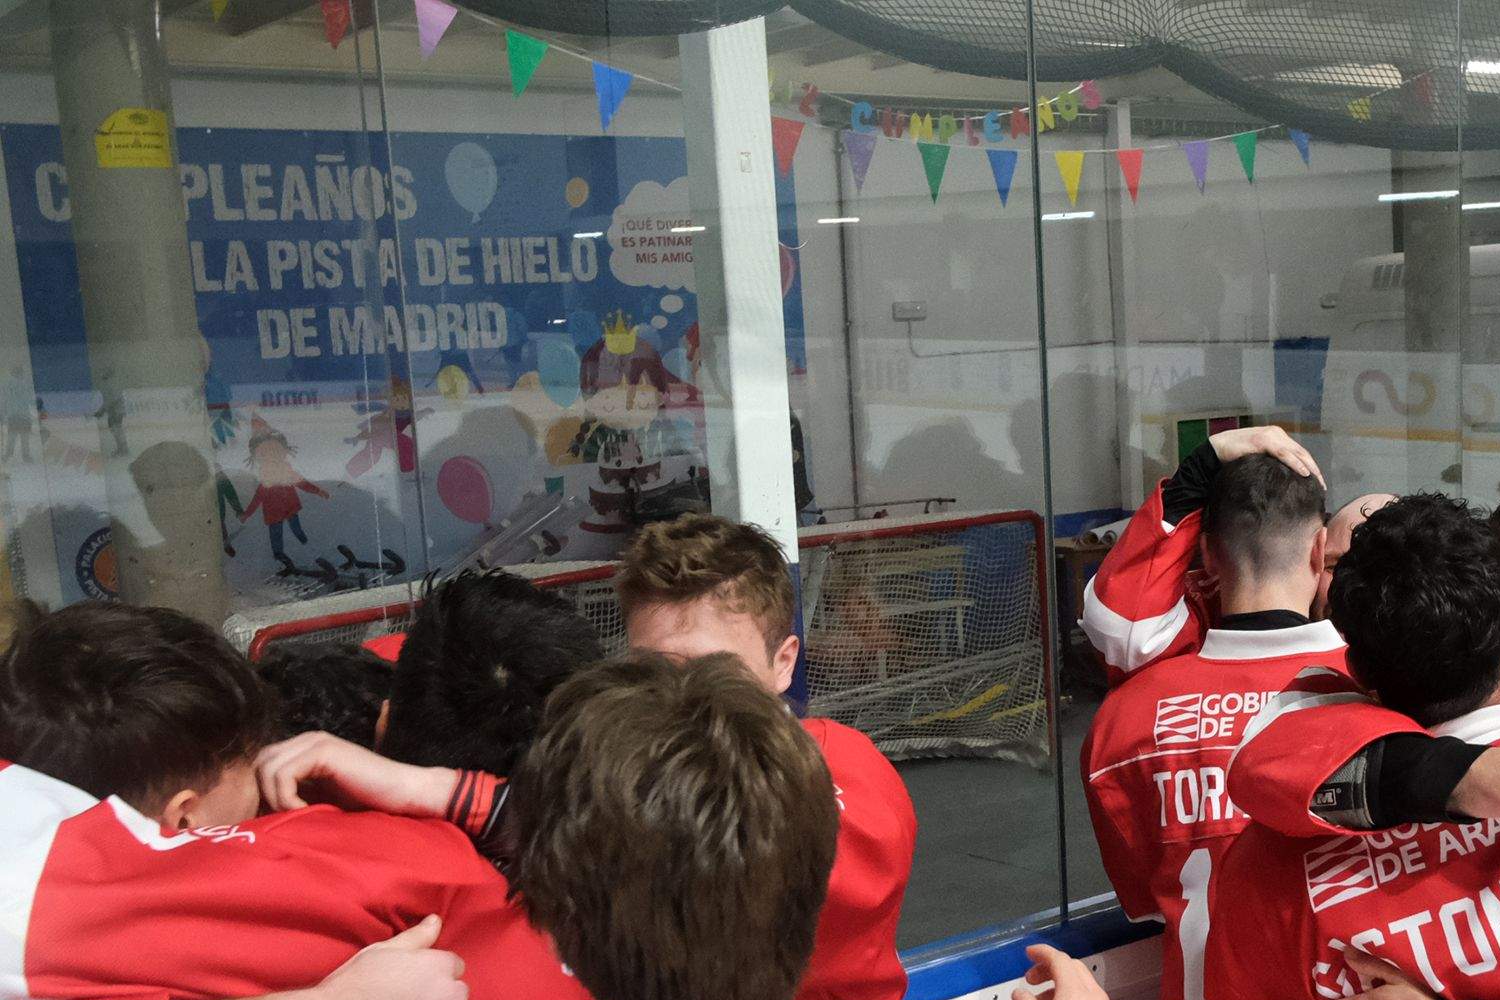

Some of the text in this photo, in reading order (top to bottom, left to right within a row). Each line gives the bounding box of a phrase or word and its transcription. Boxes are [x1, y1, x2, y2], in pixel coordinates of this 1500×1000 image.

[35, 154, 417, 222] CPLEAÑOS
[190, 236, 598, 291] LA PISTA DE HIELO
[621, 235, 693, 248] ES PATINAR
[635, 252, 657, 264] MIS
[257, 302, 508, 359] DE MADRID
[1200, 716, 1235, 739] DE
[1377, 836, 1426, 884] DE
